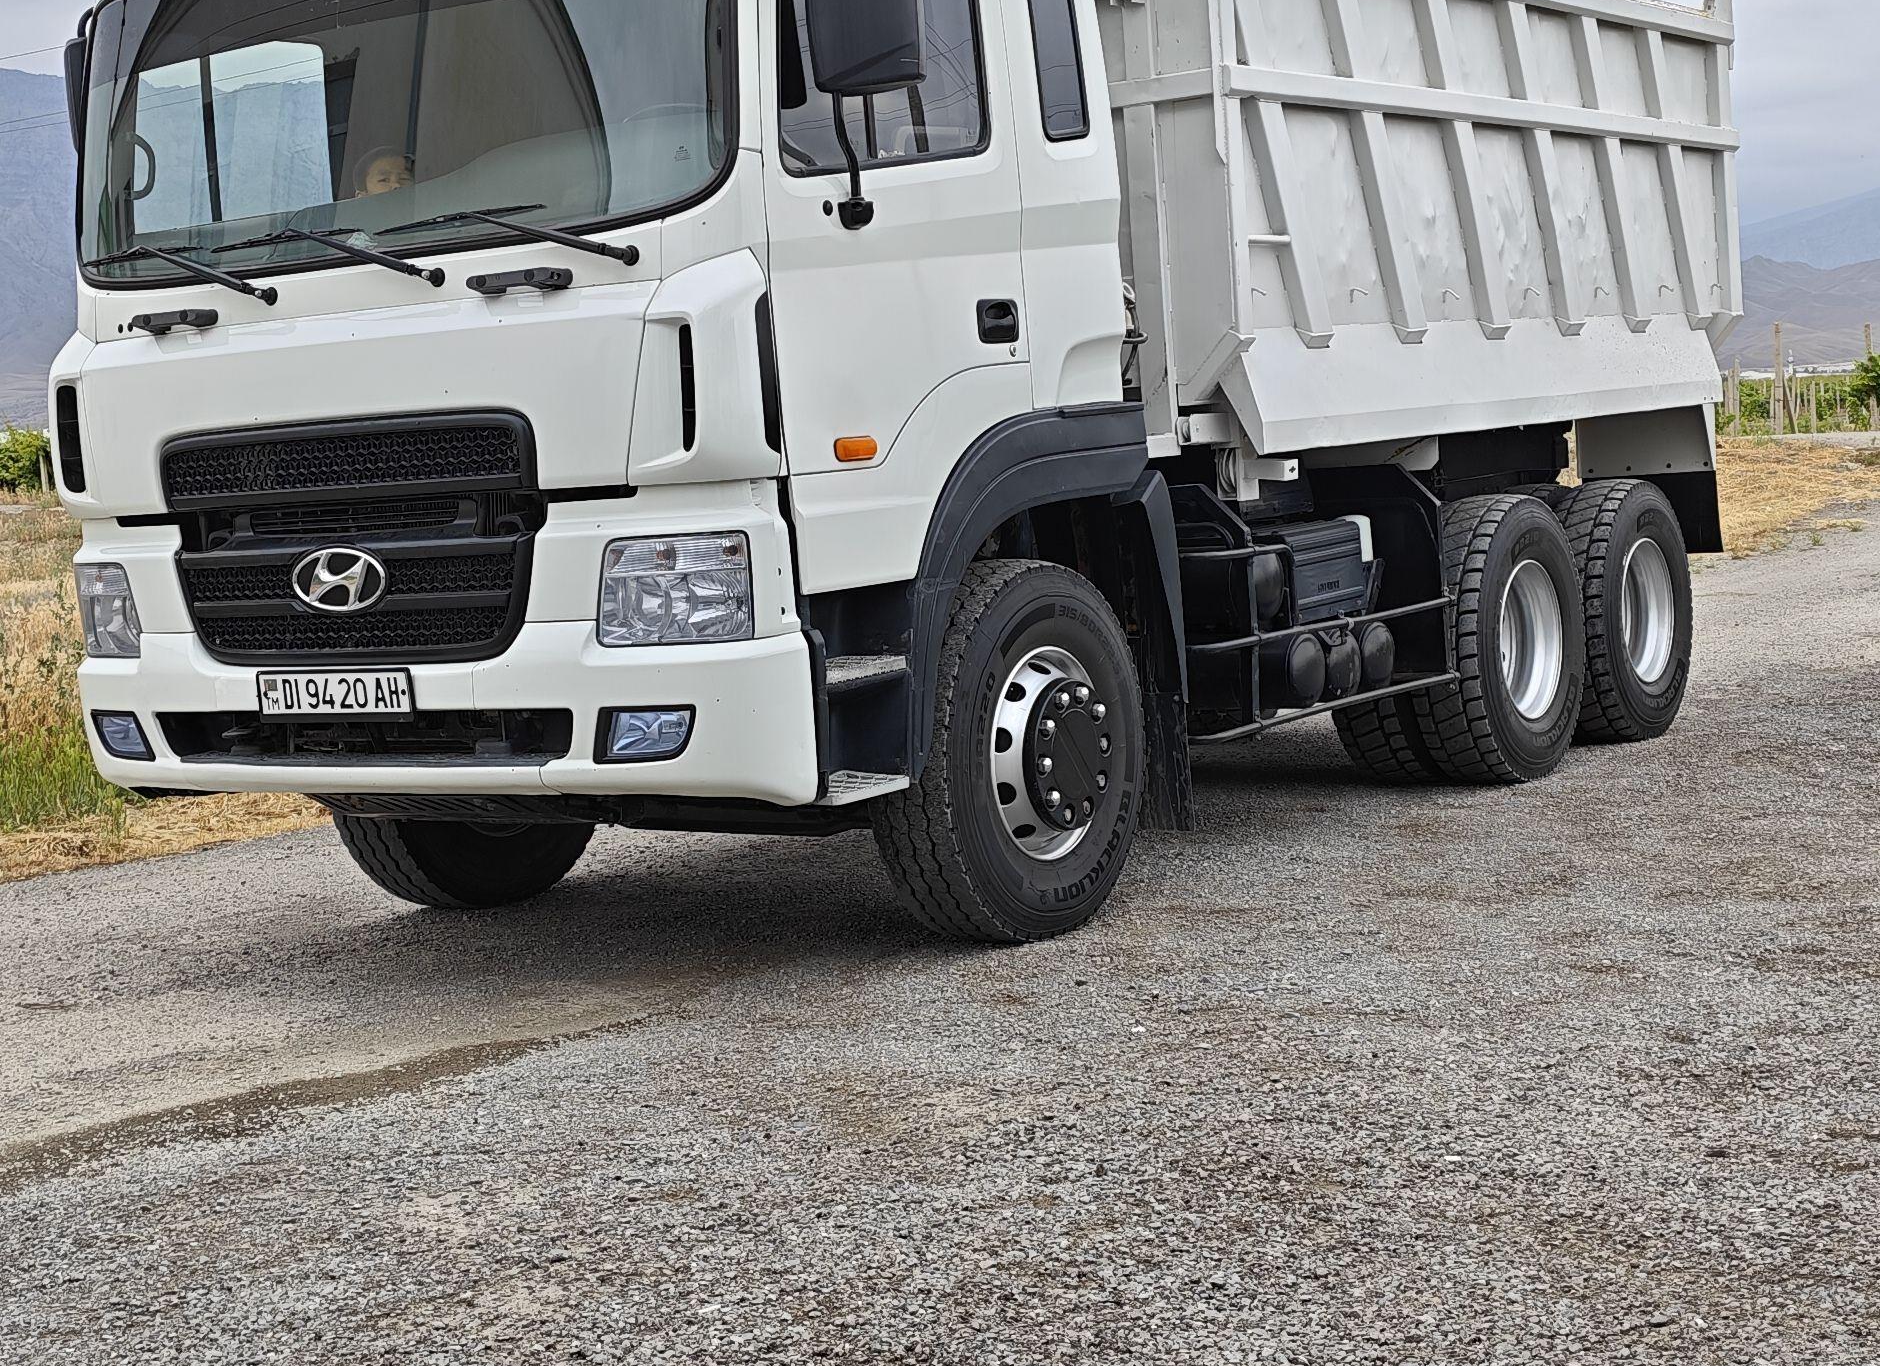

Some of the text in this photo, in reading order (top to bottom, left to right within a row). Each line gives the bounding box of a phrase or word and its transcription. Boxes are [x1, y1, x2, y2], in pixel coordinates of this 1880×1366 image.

[268, 696, 280, 710] TM
[282, 676, 401, 710] DI 9420 AH
[1053, 790, 1131, 903] BLACKLION
